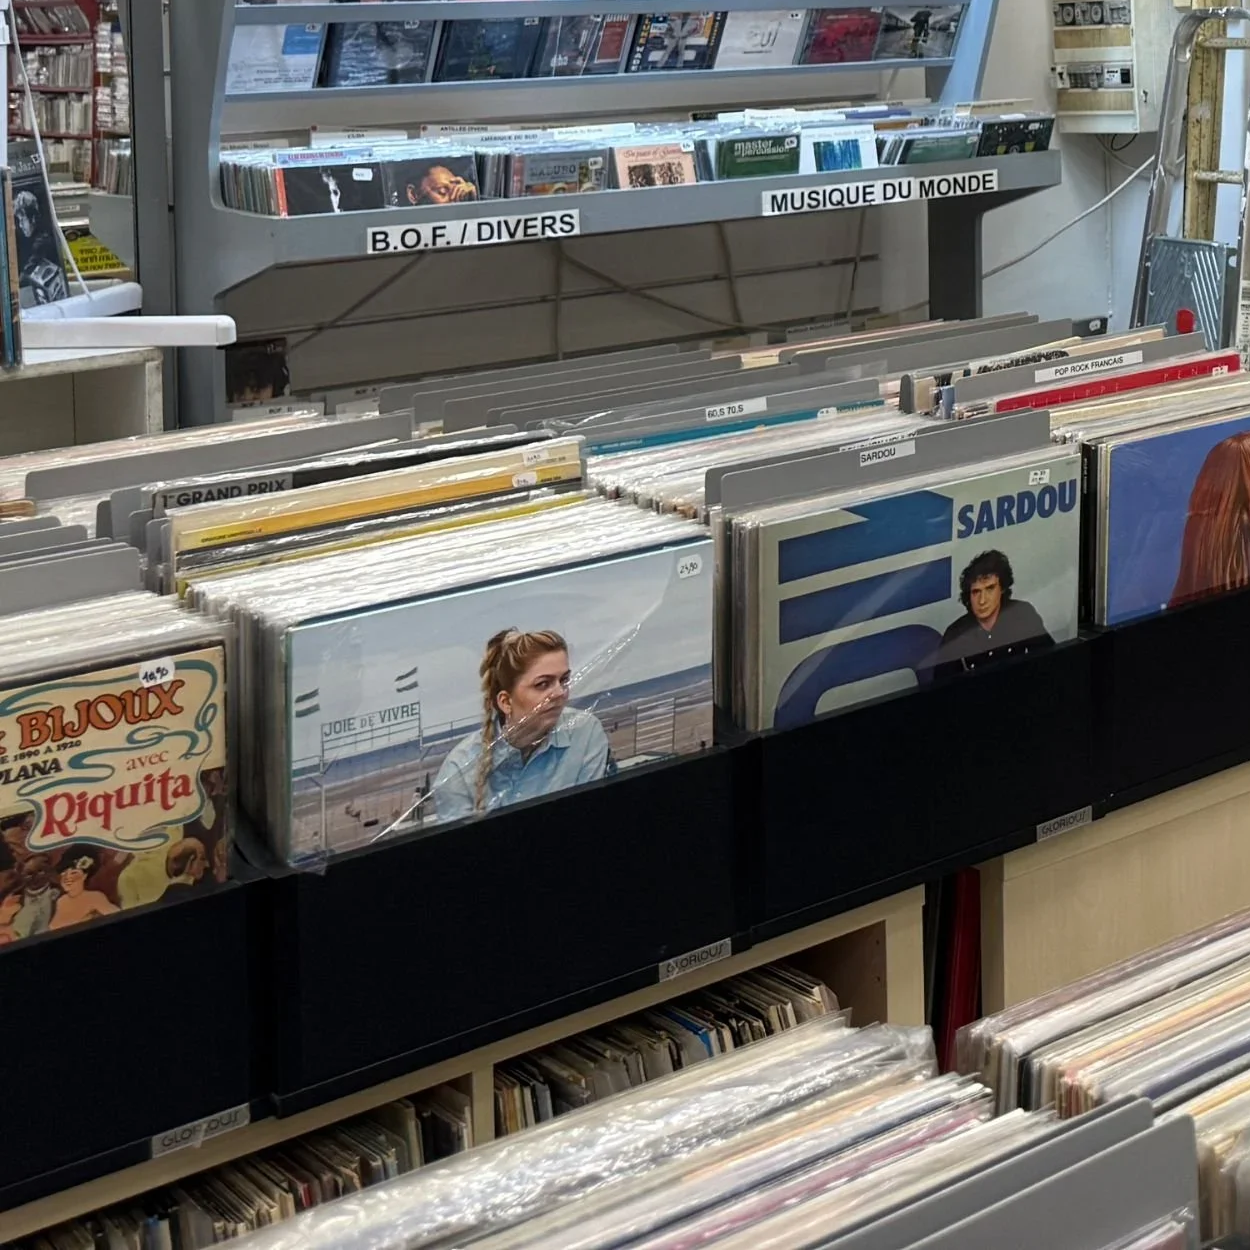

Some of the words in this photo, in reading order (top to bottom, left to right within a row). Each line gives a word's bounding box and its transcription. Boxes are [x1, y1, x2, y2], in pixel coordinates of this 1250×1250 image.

[734, 140, 775, 151] master
[770, 183, 876, 214] MUSIQUE
[882, 180, 912, 202] DU
[918, 172, 996, 199] MONDE
[371, 229, 451, 253] B.O.F.
[460, 223, 468, 245] /
[476, 213, 576, 243] DIVERS
[1054, 365, 1067, 377] POP
[1067, 363, 1085, 375] ROCK
[1085, 357, 1125, 372] FRANCAIS
[860, 447, 897, 464] SARDOU
[176, 484, 244, 507] GRAND
[248, 478, 288, 498] PRIX
[956, 477, 1078, 540] SARDOU
[17, 678, 185, 751] BIJOUX
[323, 715, 358, 739] JOIE
[378, 701, 420, 725] VIVRE
[13, 747, 41, 762] 1890
[55, 739, 82, 754] 1920
[125, 749, 170, 772] avec
[40, 765, 195, 839] Riquita
[1040, 808, 1087, 838] GLORIOUS
